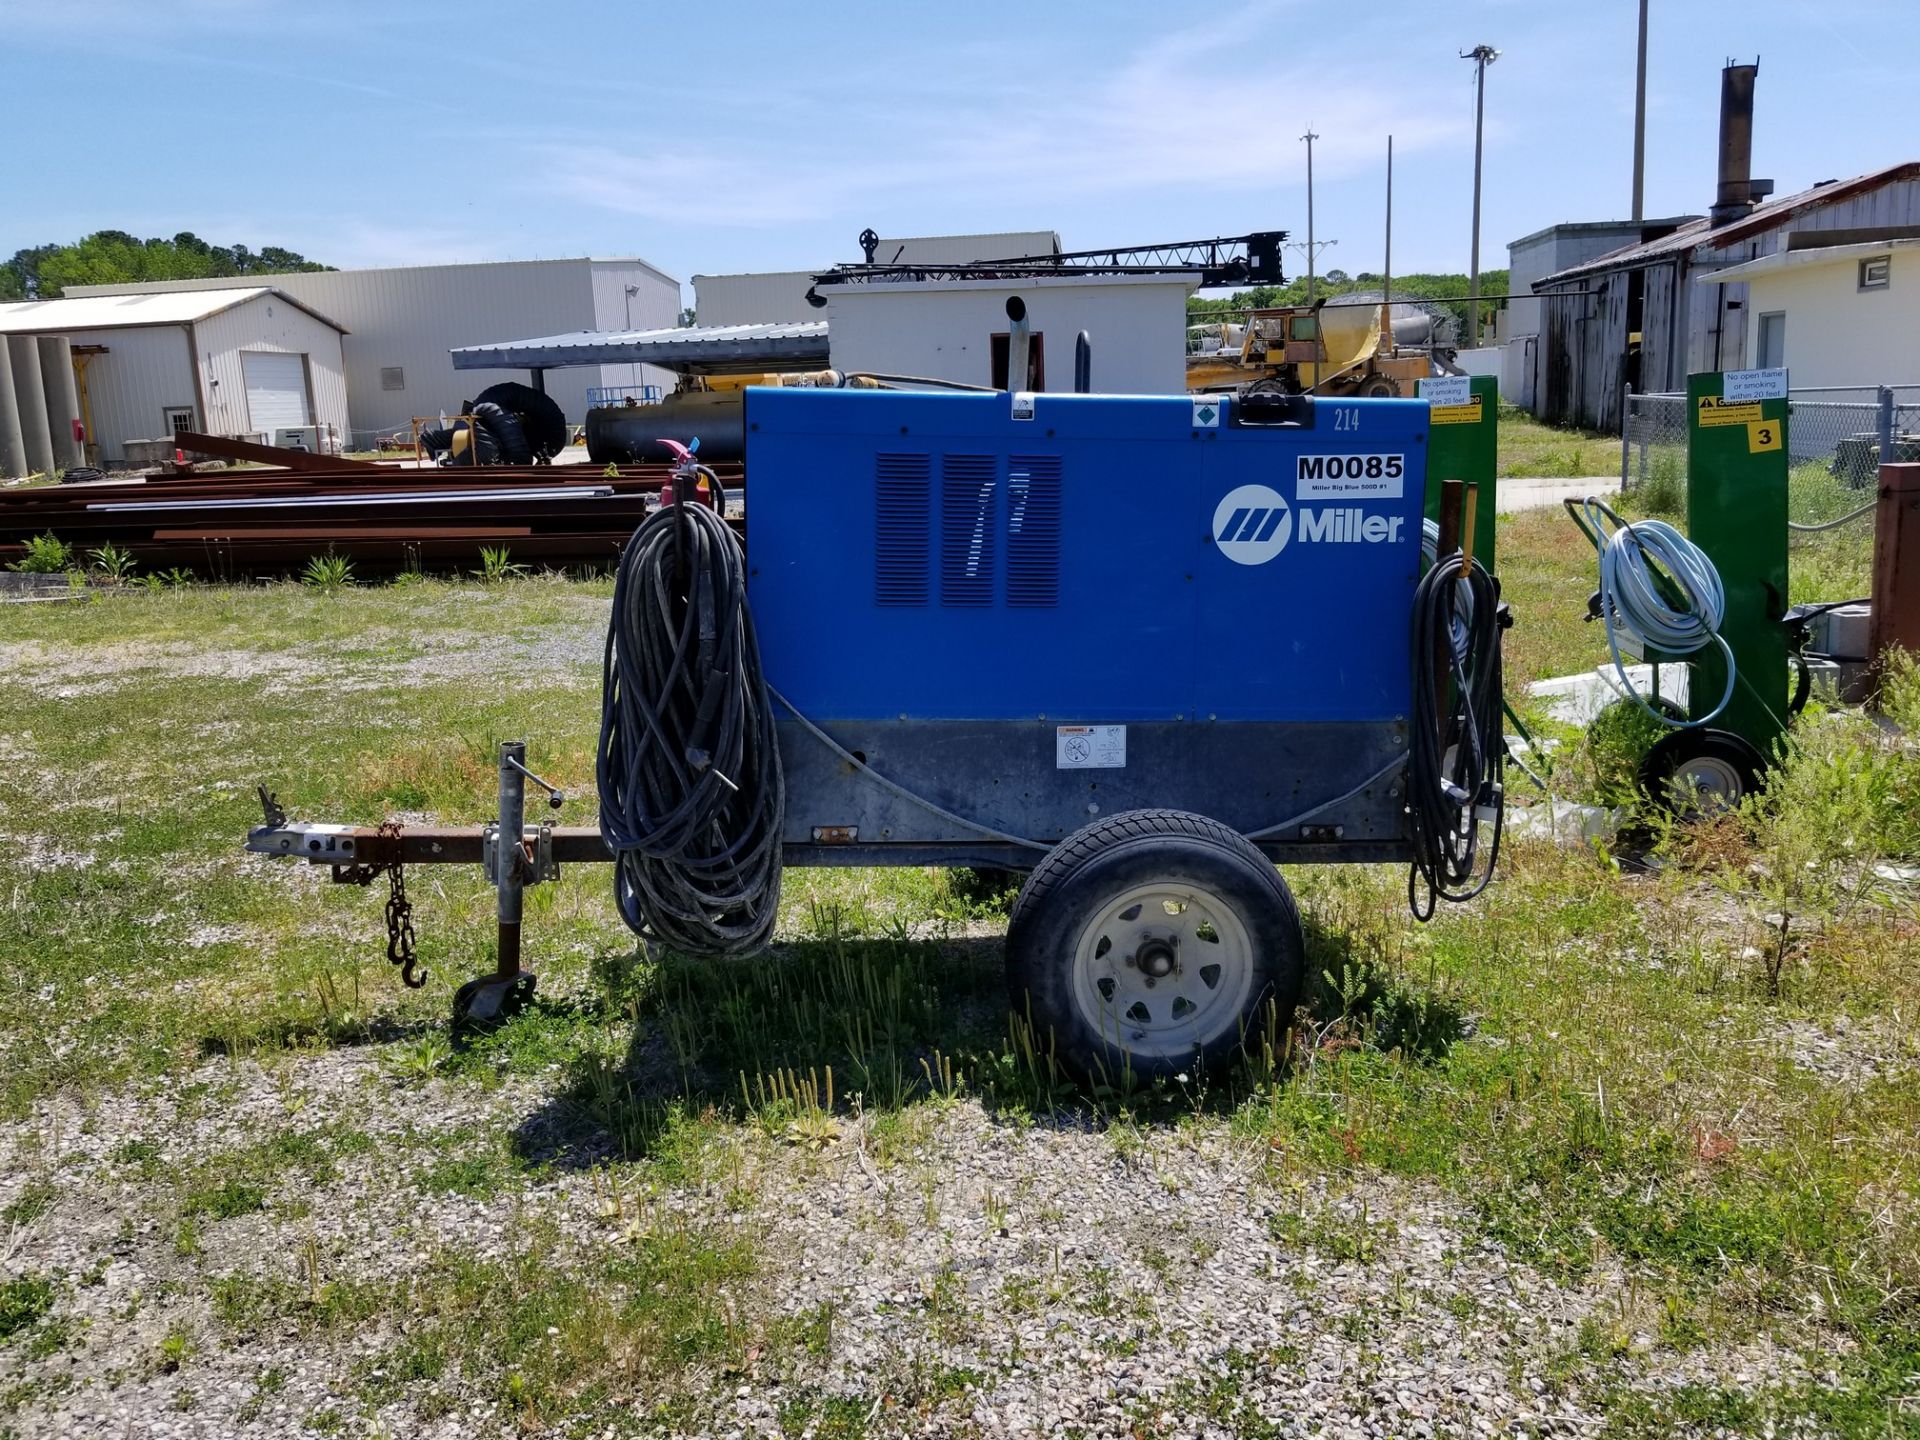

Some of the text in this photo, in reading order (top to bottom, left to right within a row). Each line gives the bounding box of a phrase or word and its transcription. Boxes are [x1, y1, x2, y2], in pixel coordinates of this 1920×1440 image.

[1432, 380, 1449, 388] open
[1743, 381, 1776, 389] smoking
[1730, 392, 1752, 400] within
[1334, 407, 1360, 431] 214
[1757, 428, 1772, 445] 3
[1298, 455, 1403, 480] M0085
[1298, 508, 1404, 543] Miller
